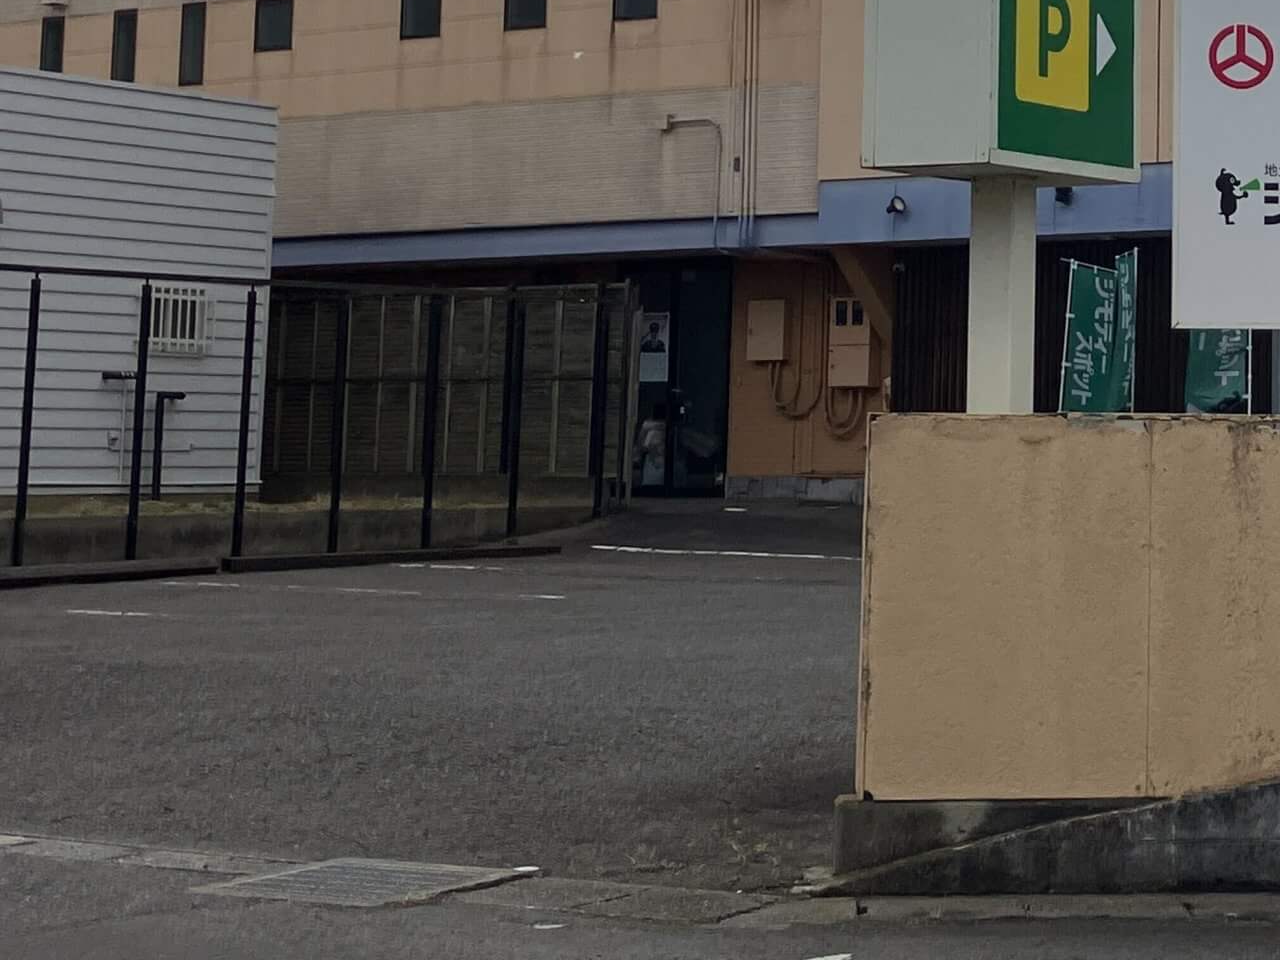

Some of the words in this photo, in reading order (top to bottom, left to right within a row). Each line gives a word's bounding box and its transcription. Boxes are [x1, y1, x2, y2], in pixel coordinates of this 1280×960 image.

[1071, 331, 1095, 405] スポット
[1094, 277, 1114, 374] ジモティー
